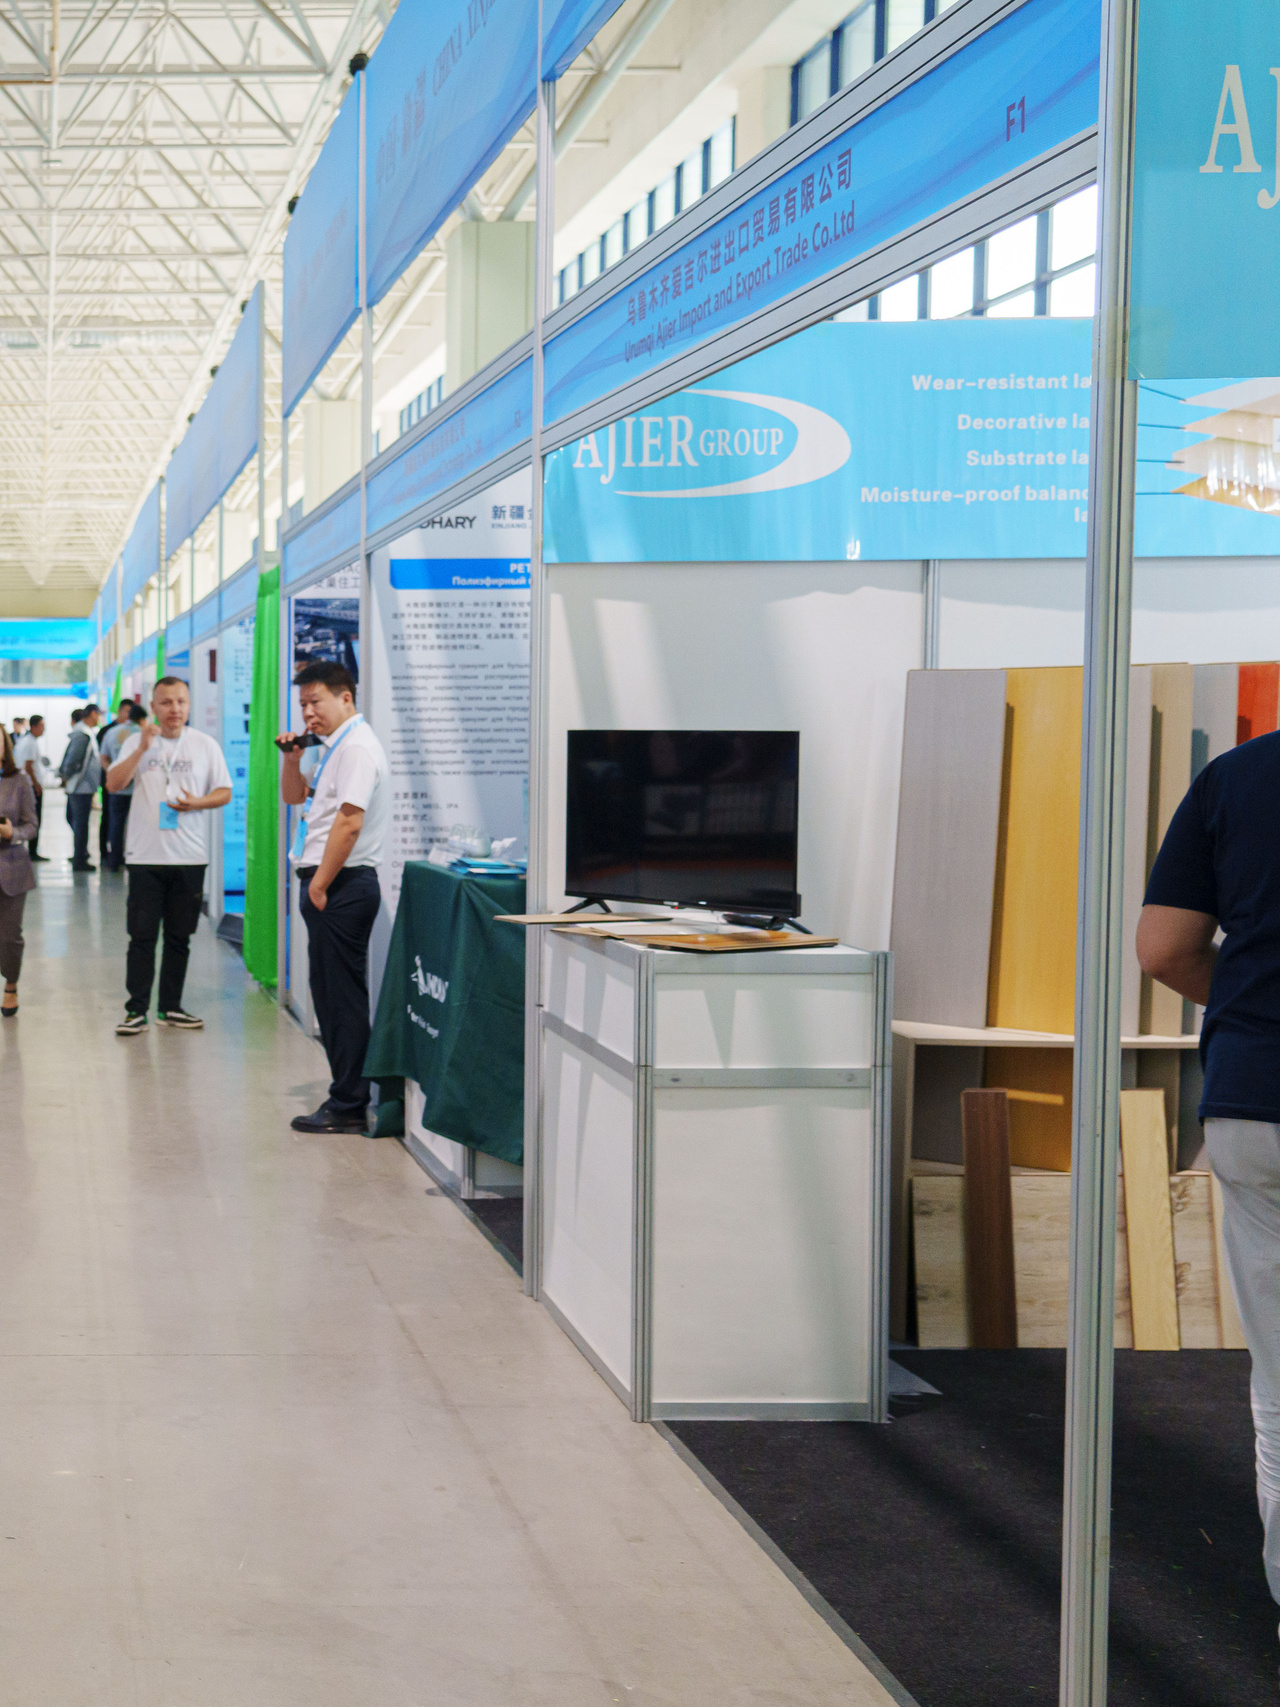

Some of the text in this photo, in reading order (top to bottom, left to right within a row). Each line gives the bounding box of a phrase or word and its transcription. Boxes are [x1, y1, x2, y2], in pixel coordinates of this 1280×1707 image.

[1006, 96, 1026, 142] F1
[657, 316, 677, 350] Ajier
[679, 294, 712, 334] Import
[714, 276, 733, 313] and
[736, 256, 771, 300] Export
[774, 232, 809, 276] Trade
[812, 199, 855, 253] Co.Ltd
[957, 413, 1067, 430] Decorative
[572, 416, 699, 485] AJIER
[699, 427, 784, 457] GROUP
[966, 449, 1067, 466] Substrate
